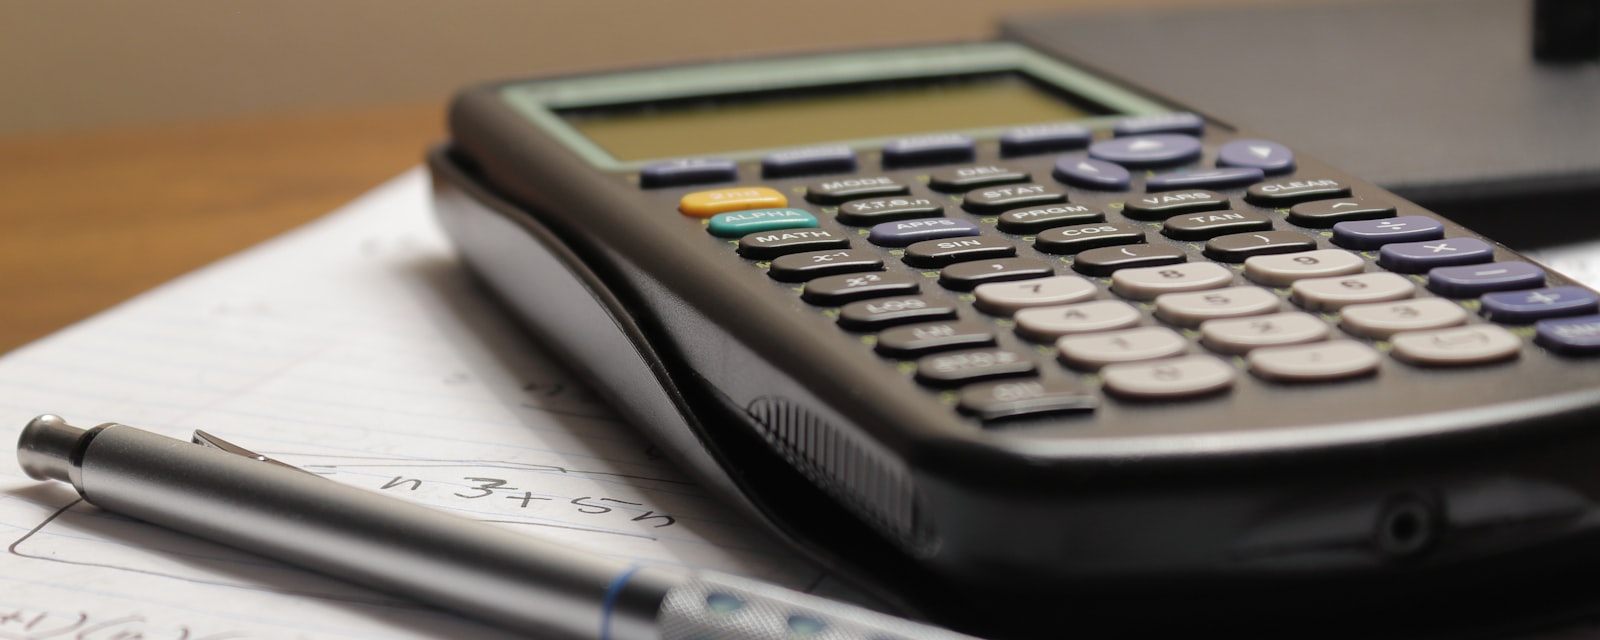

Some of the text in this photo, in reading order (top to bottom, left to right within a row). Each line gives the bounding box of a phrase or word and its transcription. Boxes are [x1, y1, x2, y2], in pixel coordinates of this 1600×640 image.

[957, 165, 1007, 177] DEL
[822, 177, 894, 190] MODE
[1262, 179, 1339, 192] CLEAR
[709, 189, 760, 200] 2nd
[983, 185, 1045, 198] STAT
[1143, 192, 1212, 205] VARS
[725, 210, 801, 223] ALPHA
[1012, 205, 1089, 219] PRGM
[1189, 213, 1245, 223] TAN
[897, 219, 954, 230] APPS
[1062, 225, 1118, 236] COS
[755, 231, 832, 243] MATH
[937, 239, 982, 249] SIN
[1158, 269, 1185, 279] 8
[1018, 283, 1043, 293] 7
[866, 299, 926, 313] LOG
